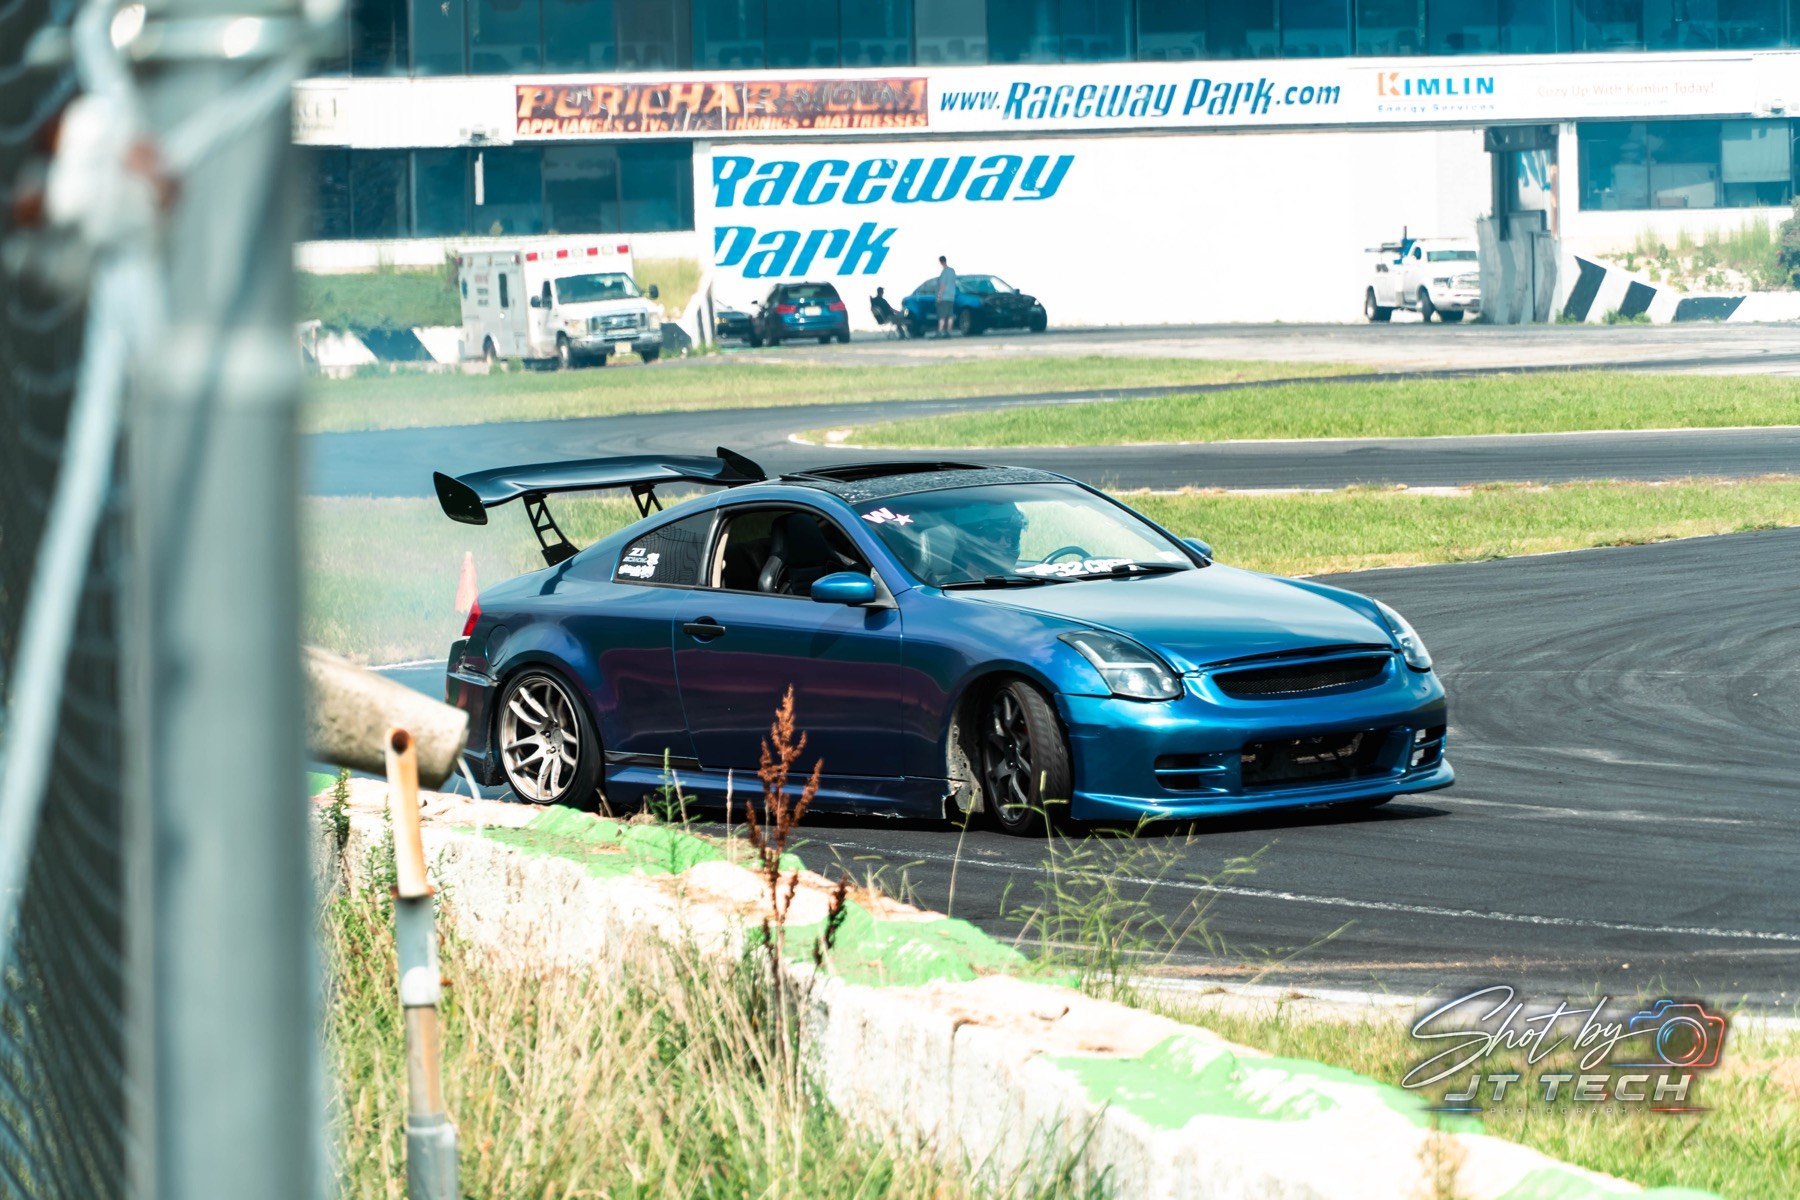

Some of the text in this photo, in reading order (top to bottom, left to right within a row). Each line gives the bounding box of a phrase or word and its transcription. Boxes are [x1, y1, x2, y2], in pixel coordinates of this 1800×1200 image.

[1377, 72, 1495, 97] KIMLIN
[1592, 83, 1622, 95] With
[1674, 81, 1715, 95] Today!
[712, 155, 1075, 208] Raceway
[713, 222, 898, 279] Park
